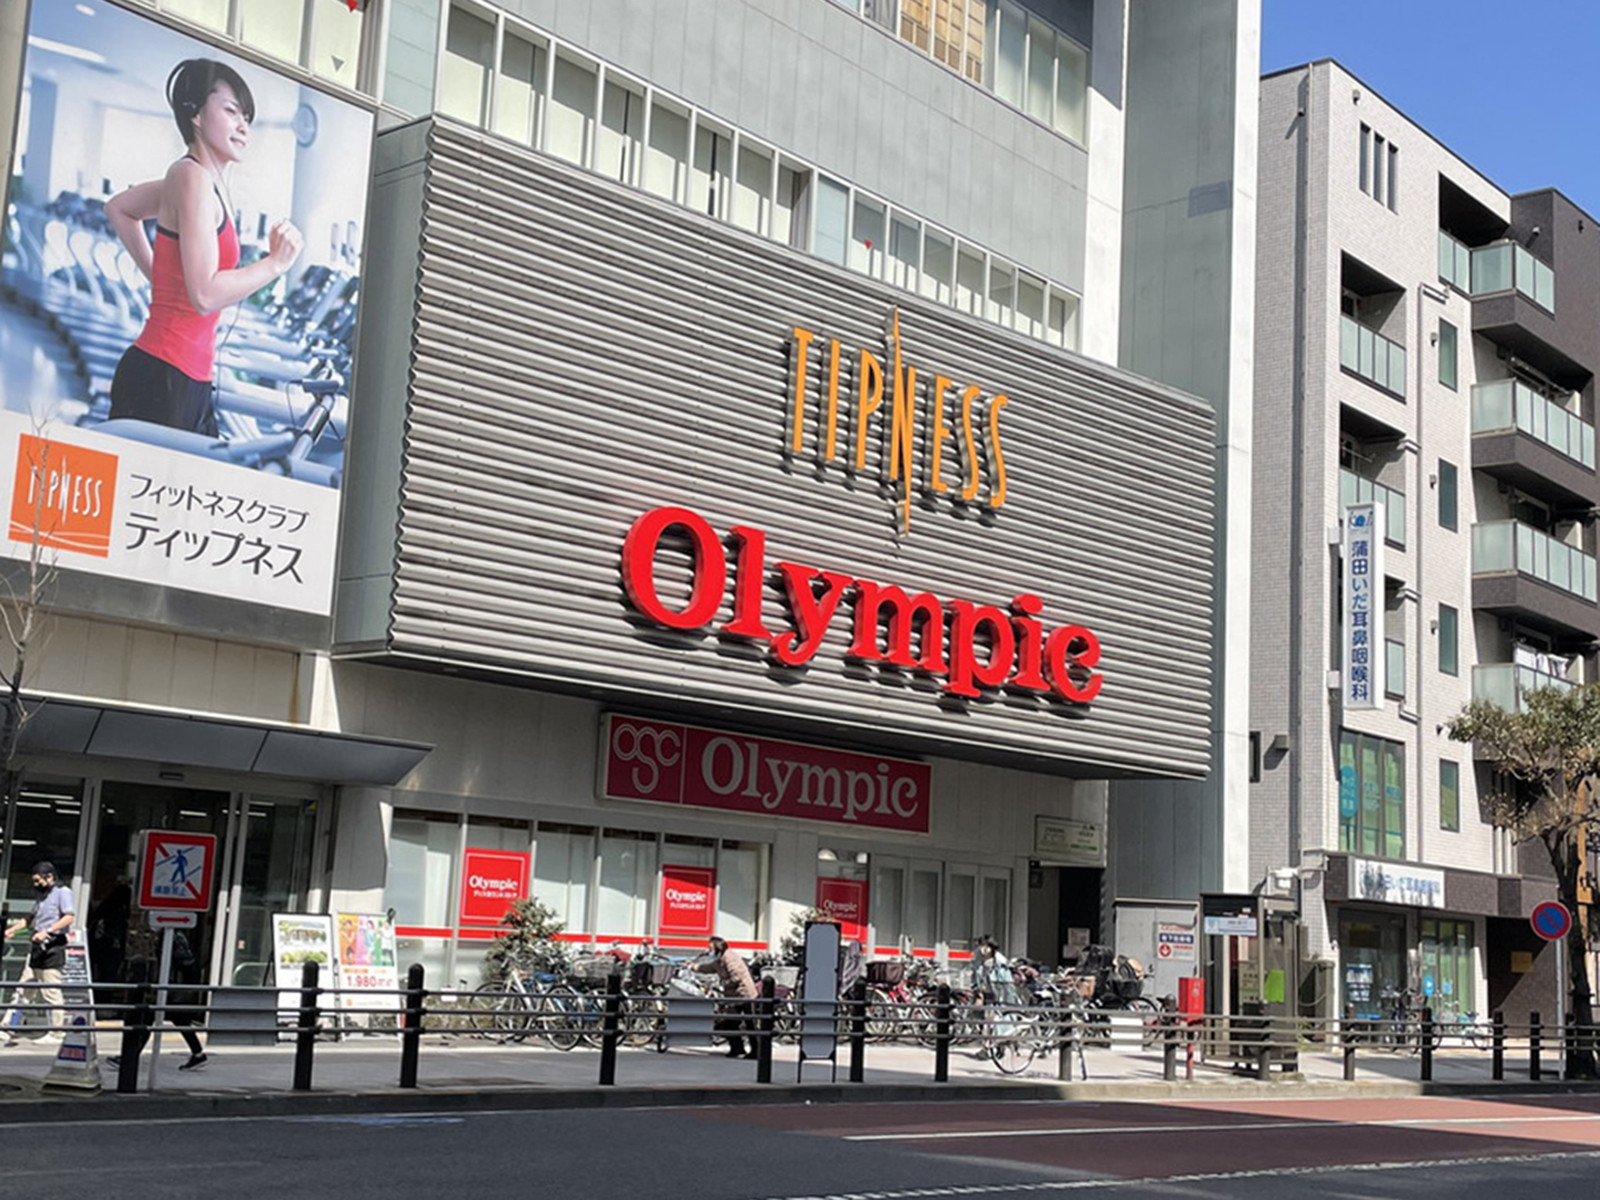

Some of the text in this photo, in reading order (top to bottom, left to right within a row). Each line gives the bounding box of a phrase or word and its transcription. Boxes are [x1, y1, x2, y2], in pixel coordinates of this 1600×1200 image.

[792, 305, 1009, 536] TIPNESS
[28, 456, 103, 526] TPNESS
[130, 474, 310, 533] フィットネスクラブ
[125, 512, 303, 584] ティップネス
[622, 505, 1103, 702] Olympic
[1351, 540, 1369, 700] 蒲田いだ耳鼻咽喉科
[702, 736, 919, 820] Olympic
[469, 874, 518, 891] Olympic
[665, 888, 707, 903] Olympic
